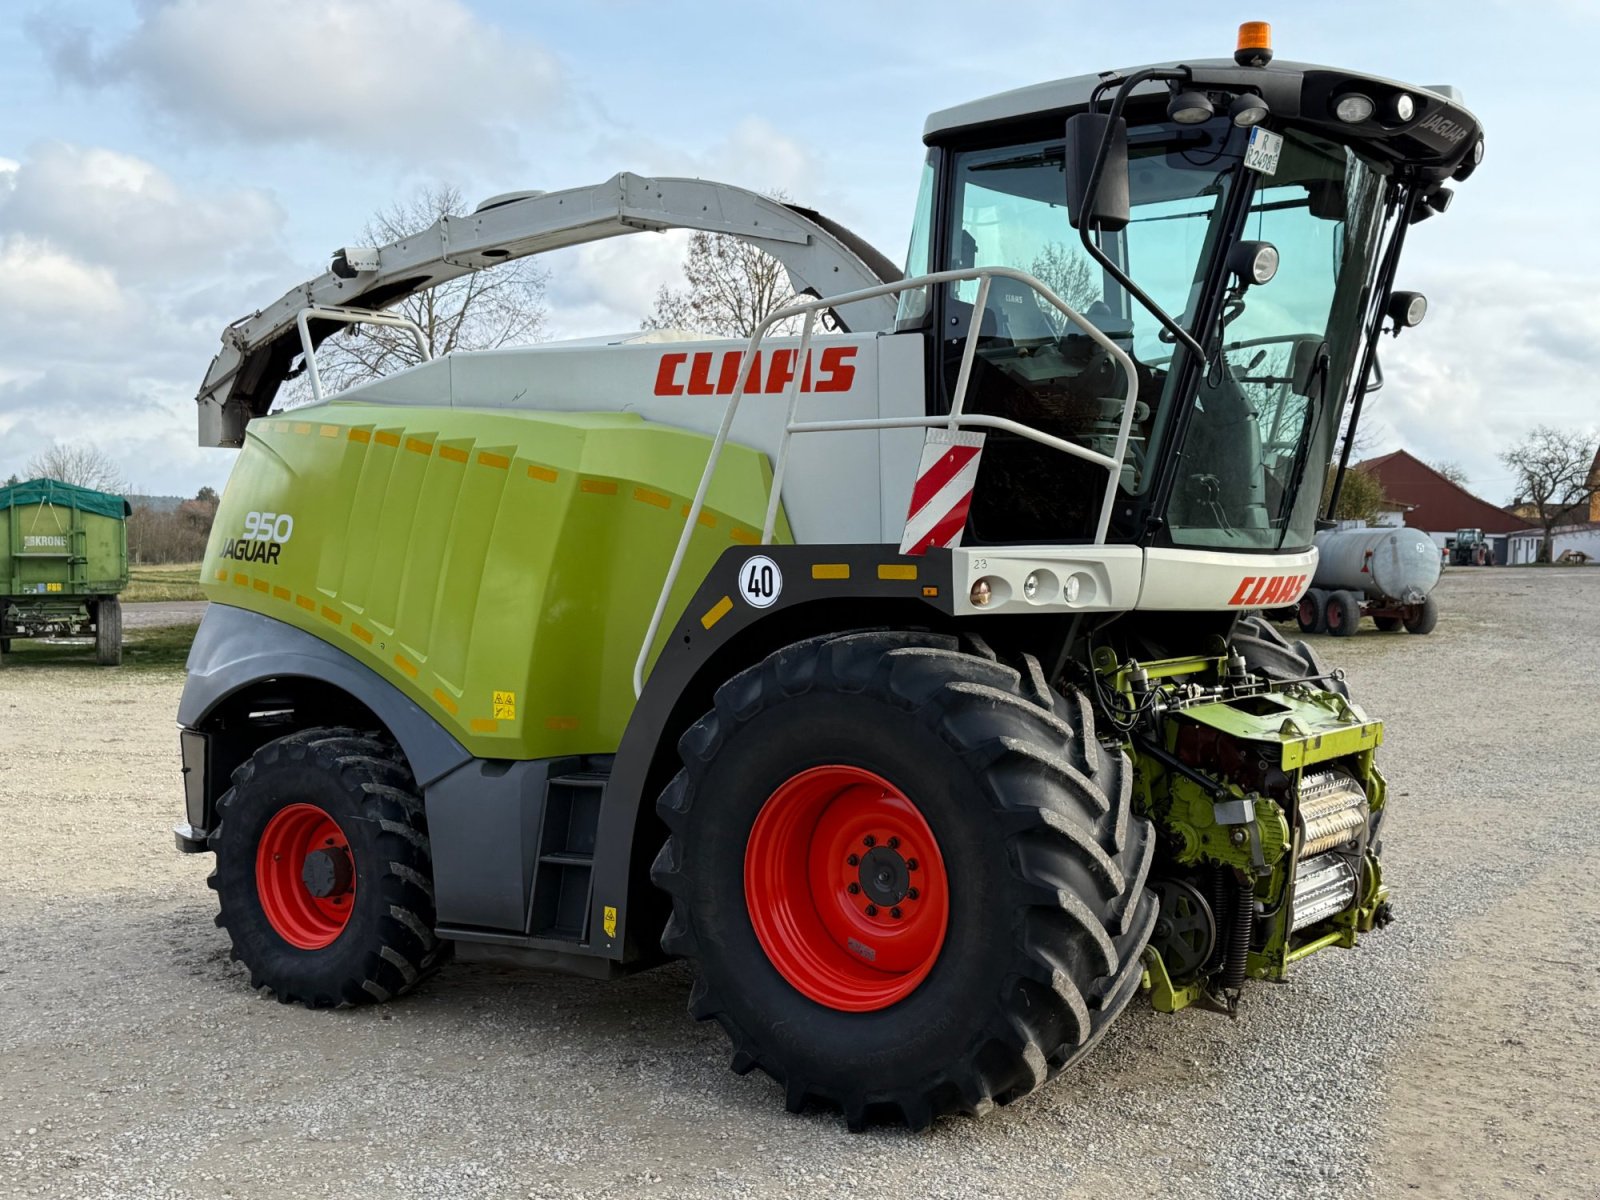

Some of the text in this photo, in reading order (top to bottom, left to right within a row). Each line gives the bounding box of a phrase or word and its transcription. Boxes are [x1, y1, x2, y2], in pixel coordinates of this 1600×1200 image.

[1261, 134, 1270, 151] R
[1419, 114, 1468, 145] JAGUAR
[653, 346, 859, 397] CLAAS
[35, 535, 67, 546] KRONE
[242, 511, 294, 544] 950
[219, 537, 281, 565] JAGUAR
[973, 558, 988, 570] 23
[747, 565, 774, 598] 40
[1227, 574, 1307, 605] CLAAS
